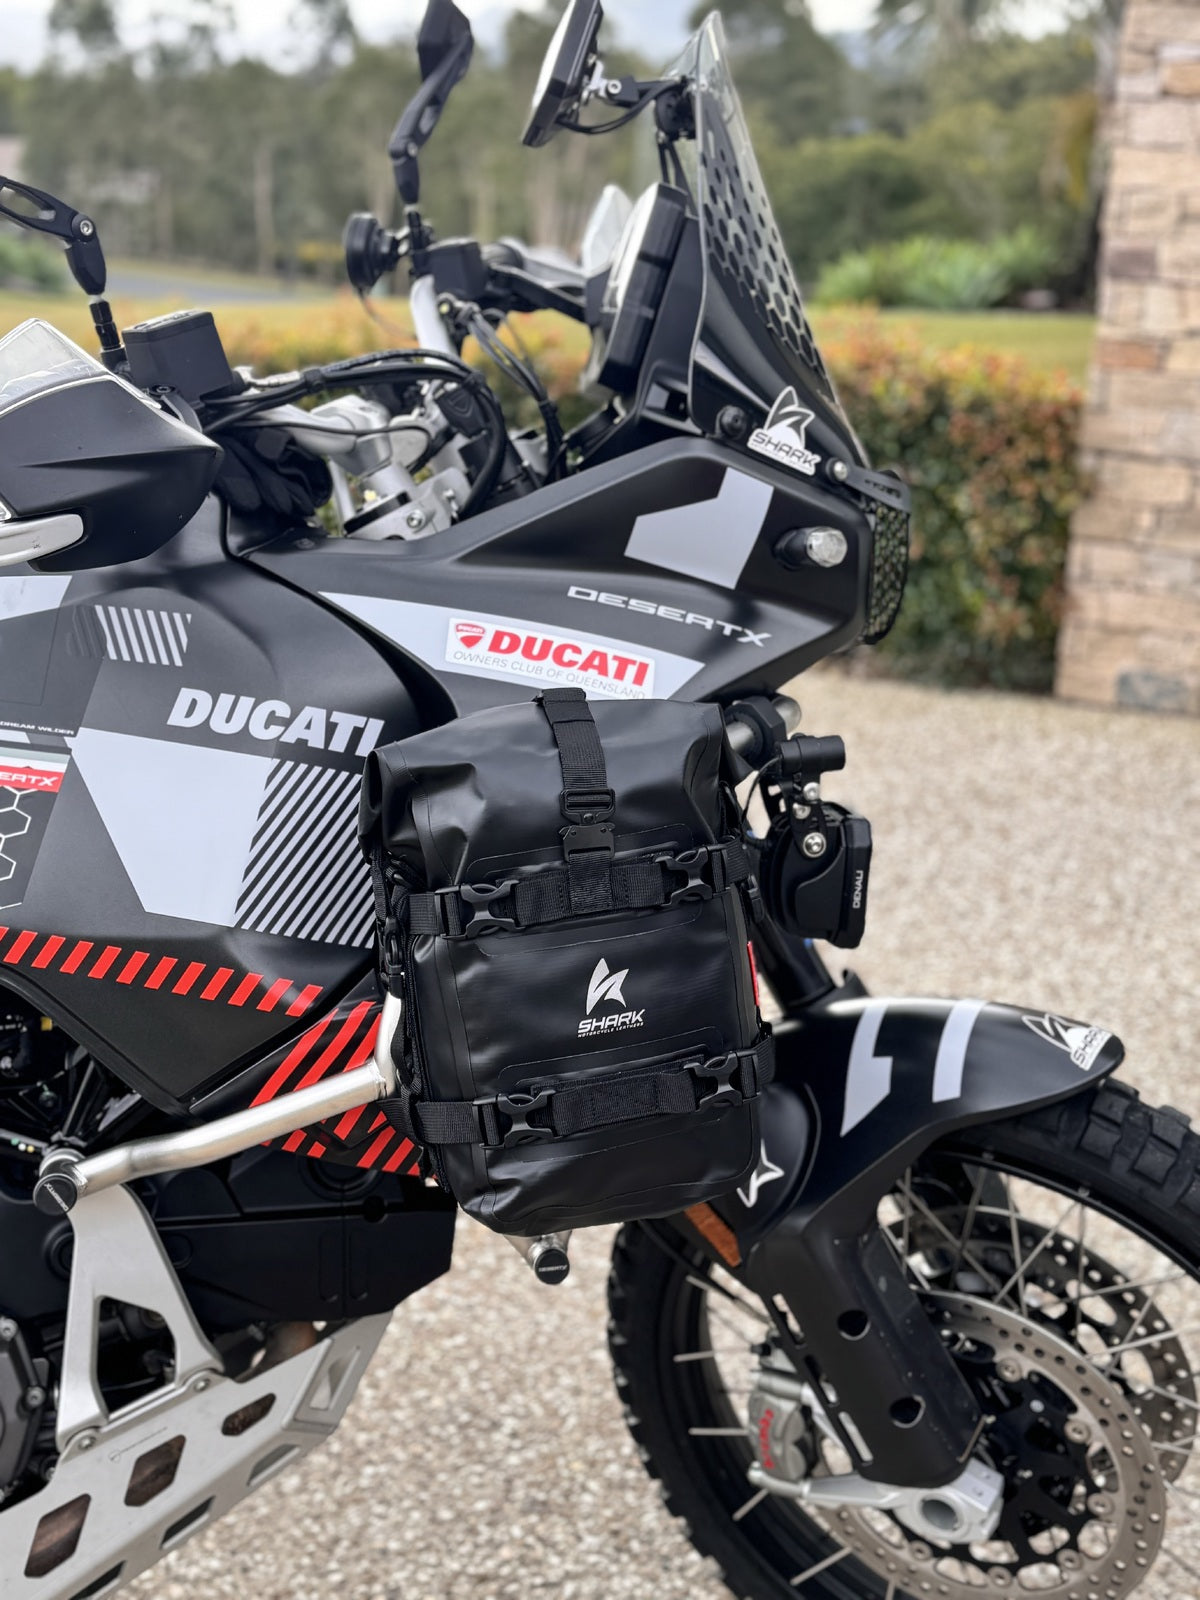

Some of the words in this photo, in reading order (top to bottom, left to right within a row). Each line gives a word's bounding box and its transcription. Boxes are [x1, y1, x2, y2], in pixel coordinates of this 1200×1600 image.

[753, 431, 818, 468] SHARK
[567, 586, 772, 646] DESERTX
[453, 650, 509, 669] OWNERS
[510, 660, 544, 676] CLUB
[546, 668, 564, 680] OF
[565, 672, 646, 700] QUEENSLAND
[487, 629, 650, 686] DUCATI
[37, 726, 75, 736] WILDER
[166, 686, 386, 758] DUCATI
[852, 870, 863, 909] DENALI
[577, 1008, 646, 1034] SHARK
[577, 1027, 615, 1038] MOTORCYCLE
